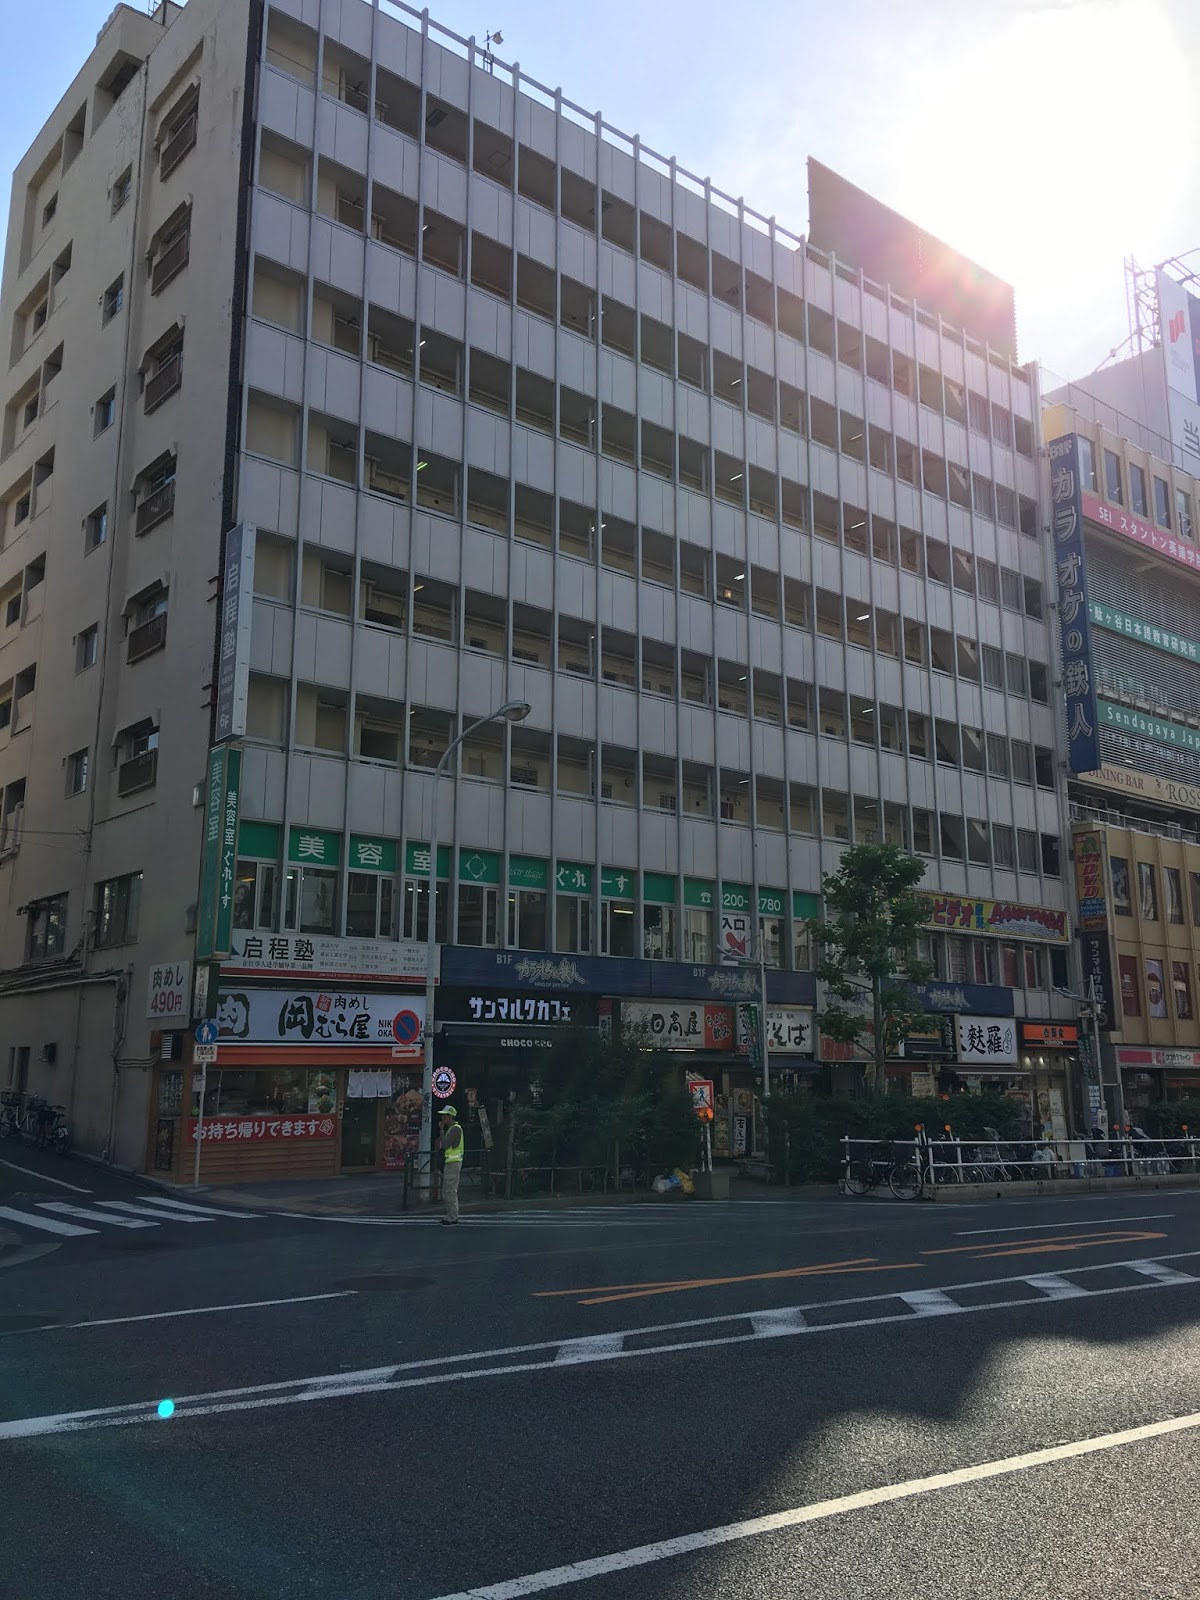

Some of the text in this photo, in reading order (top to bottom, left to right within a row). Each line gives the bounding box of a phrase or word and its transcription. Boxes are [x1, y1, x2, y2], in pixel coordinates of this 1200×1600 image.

[1098, 507, 1112, 524] SEI
[1052, 466, 1093, 741] カラオケの鉄人
[1089, 603, 1197, 658] 駄ヶ谷日本語教育研究所
[1107, 709, 1176, 740] Sendagaya
[1126, 773, 1145, 790] BAR
[208, 760, 223, 842] 美容室
[722, 917, 745, 931] 入口
[242, 936, 314, 961] 启程塾
[496, 954, 513, 964] B1F
[152, 965, 184, 991] 肉めし
[693, 968, 706, 977] B1F
[151, 991, 184, 1013] 490円
[334, 996, 371, 1012] 肉めし
[469, 996, 571, 1022] サンマルクカフェ
[767, 1021, 810, 1047] そば
[192, 1118, 320, 1141] お持ち帰りできます
